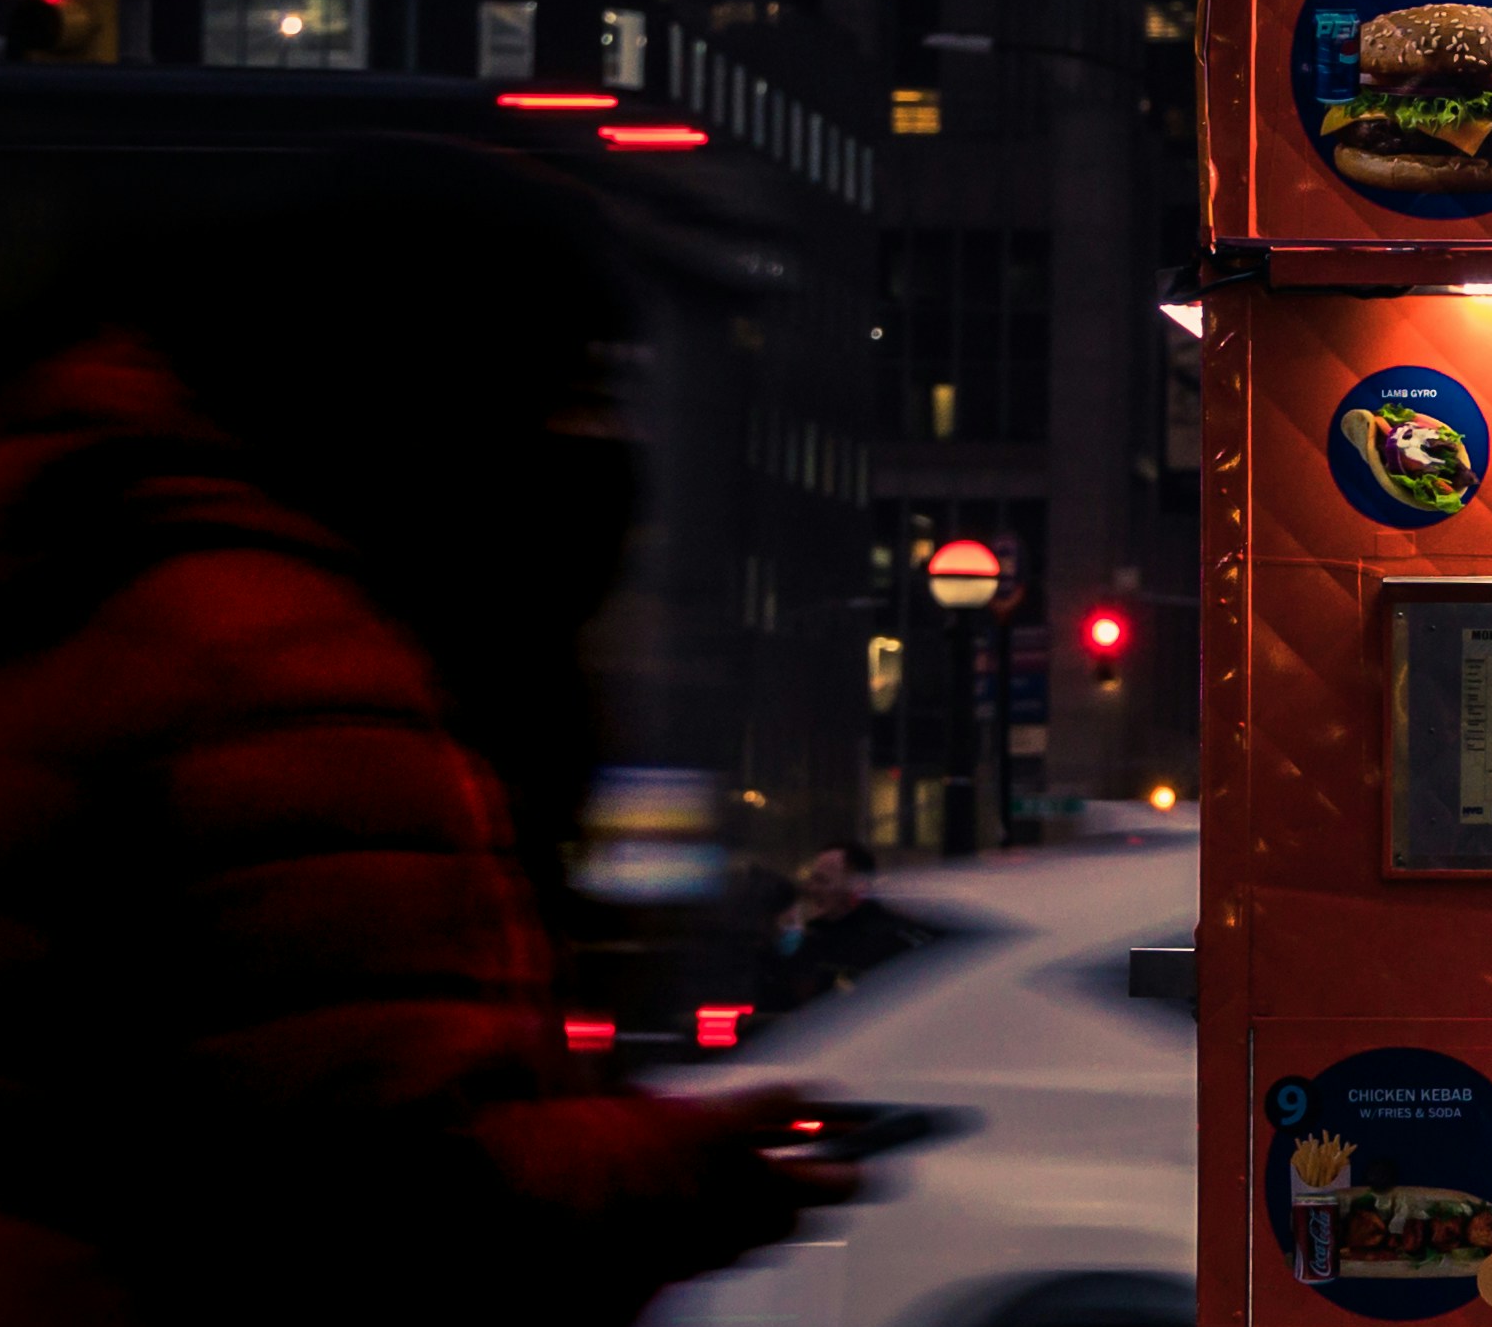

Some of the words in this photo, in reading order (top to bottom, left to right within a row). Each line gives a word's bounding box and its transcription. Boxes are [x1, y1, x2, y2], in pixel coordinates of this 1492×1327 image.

[1381, 388, 1409, 398] LAMB
[1410, 388, 1438, 398] GYRO
[1348, 1088, 1416, 1102] CHICKEN
[1420, 1087, 1473, 1102] KEBAB
[1276, 1084, 1308, 1126] 9
[1359, 1107, 1413, 1119] W/FRIES
[1415, 1107, 1426, 1119] &
[1428, 1107, 1463, 1119] SODA
